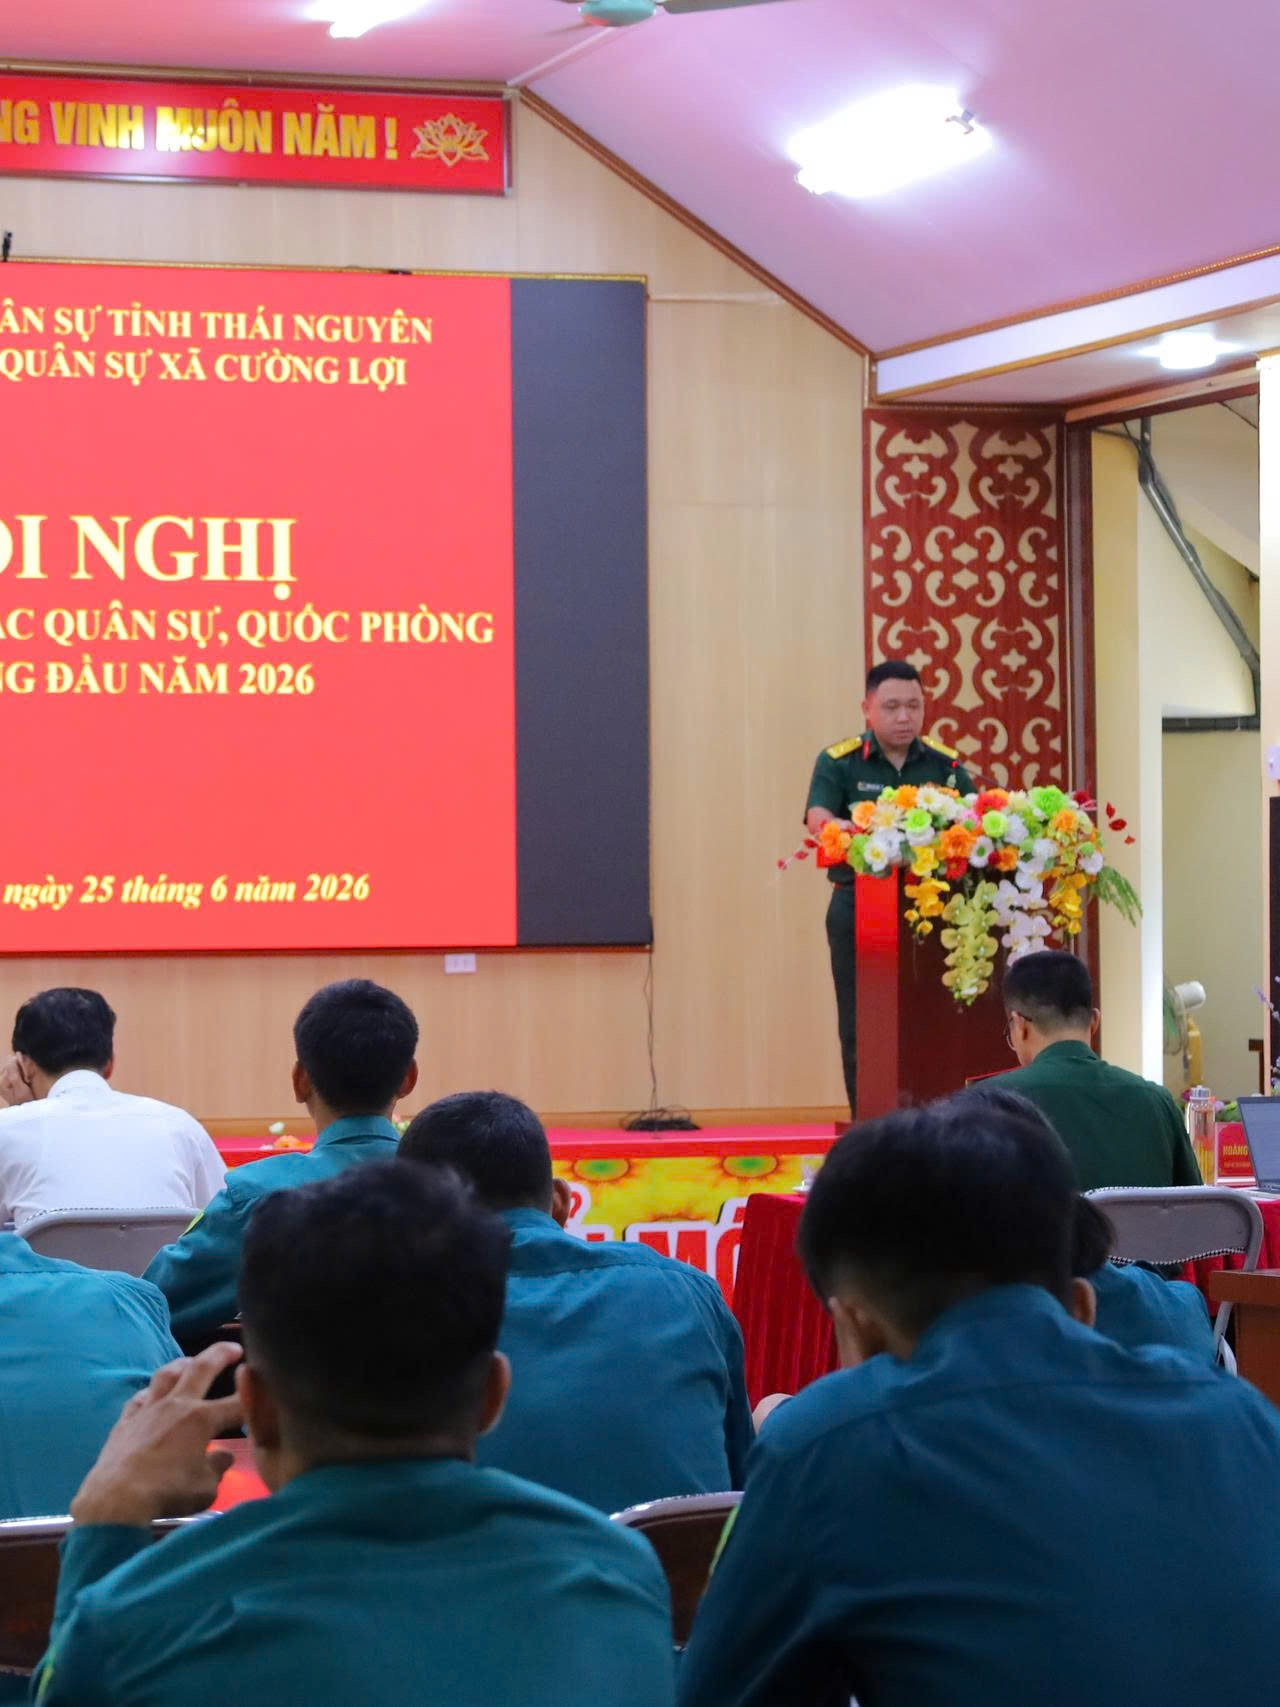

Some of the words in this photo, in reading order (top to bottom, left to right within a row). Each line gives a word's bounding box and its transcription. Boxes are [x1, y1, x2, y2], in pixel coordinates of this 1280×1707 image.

[50, 101, 145, 151] VINH
[155, 97, 273, 155] MUÔN
[282, 103, 376, 160] NĂM
[53, 304, 103, 343] SỰ
[106, 301, 192, 338] TỈNH
[199, 304, 284, 341] THÁI
[292, 308, 433, 344] NGUYÊN
[104, 347, 154, 387] SỰ
[158, 346, 208, 381] XÃ
[214, 347, 340, 385] CƯỜNG
[348, 355, 408, 392] LỢI
[69, 514, 298, 601] NGHỊ
[43, 599, 157, 646] QUÂN
[166, 605, 229, 649] SỰ,
[236, 602, 350, 648] QUỐC
[360, 603, 495, 644] PHÒNG
[45, 653, 128, 695] ĐẦU
[138, 655, 229, 695] NĂM
[238, 662, 315, 696] 2026
[2, 874, 73, 911] ngày
[79, 874, 116, 904] 25
[120, 873, 203, 909] tháng
[210, 874, 228, 903] 6
[233, 875, 297, 903] năm
[302, 873, 370, 902] 2026
